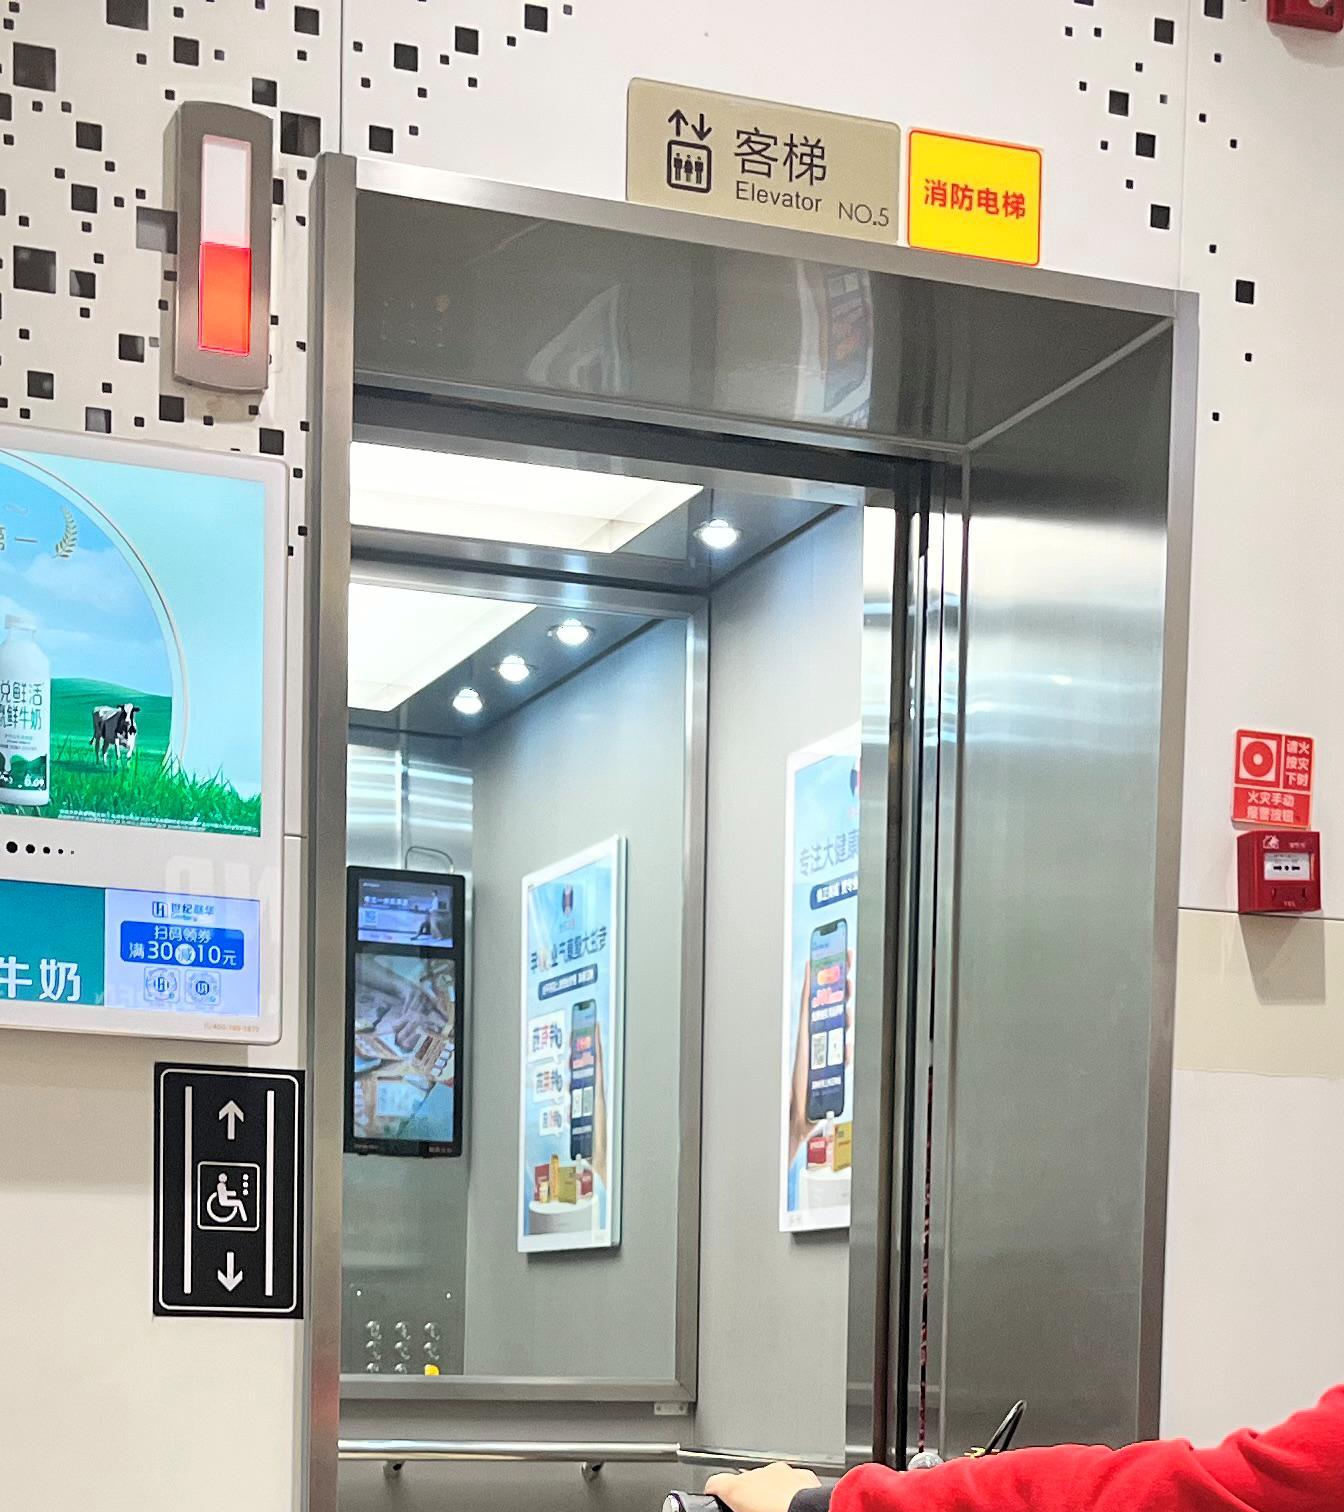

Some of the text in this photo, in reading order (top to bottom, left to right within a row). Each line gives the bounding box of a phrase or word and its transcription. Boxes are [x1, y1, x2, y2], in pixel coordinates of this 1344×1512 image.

[734, 127, 827, 187] 客梯
[735, 180, 890, 226] Elevator NO.5
[922, 177, 1027, 220] 消防电梯
